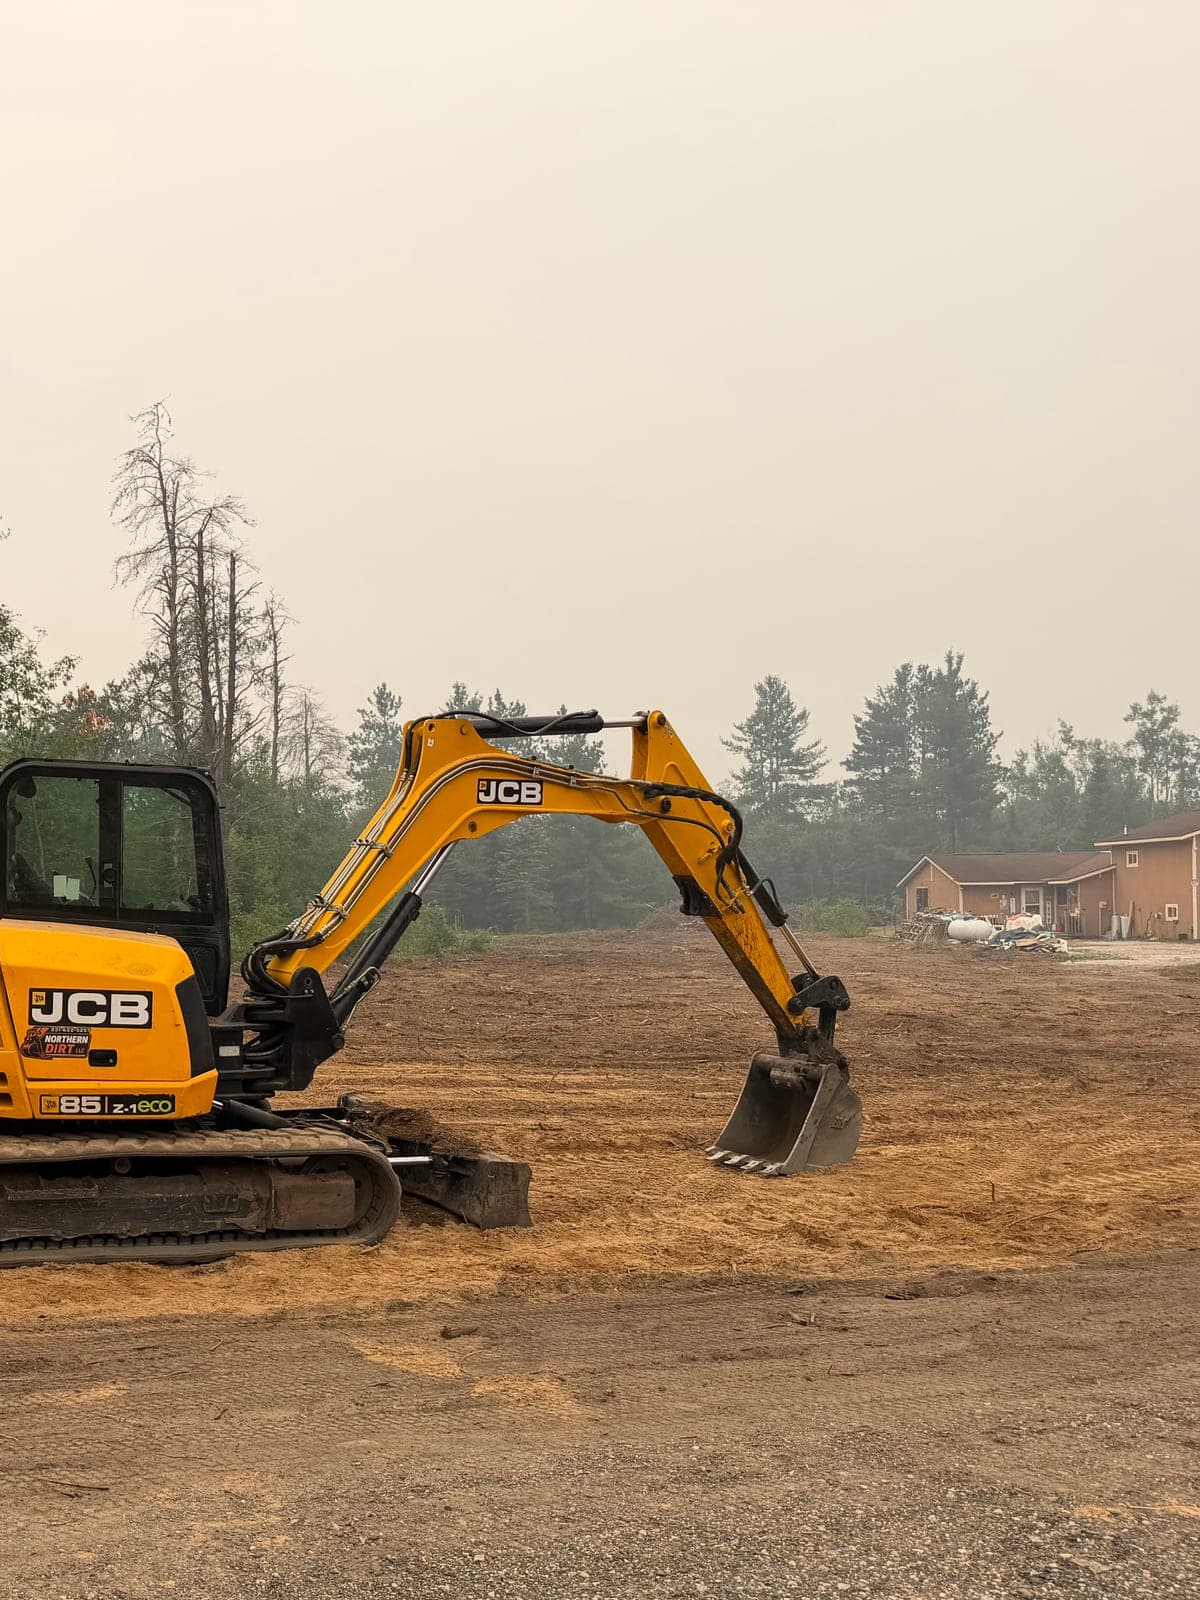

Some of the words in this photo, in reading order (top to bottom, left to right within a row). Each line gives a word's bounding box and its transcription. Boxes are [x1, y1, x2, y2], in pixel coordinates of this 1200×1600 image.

[479, 781, 541, 803] JCB
[31, 992, 149, 1025] JCB
[45, 1034, 89, 1044] NORTHERN
[45, 1043, 75, 1054] DIRT
[60, 1096, 101, 1114] 85
